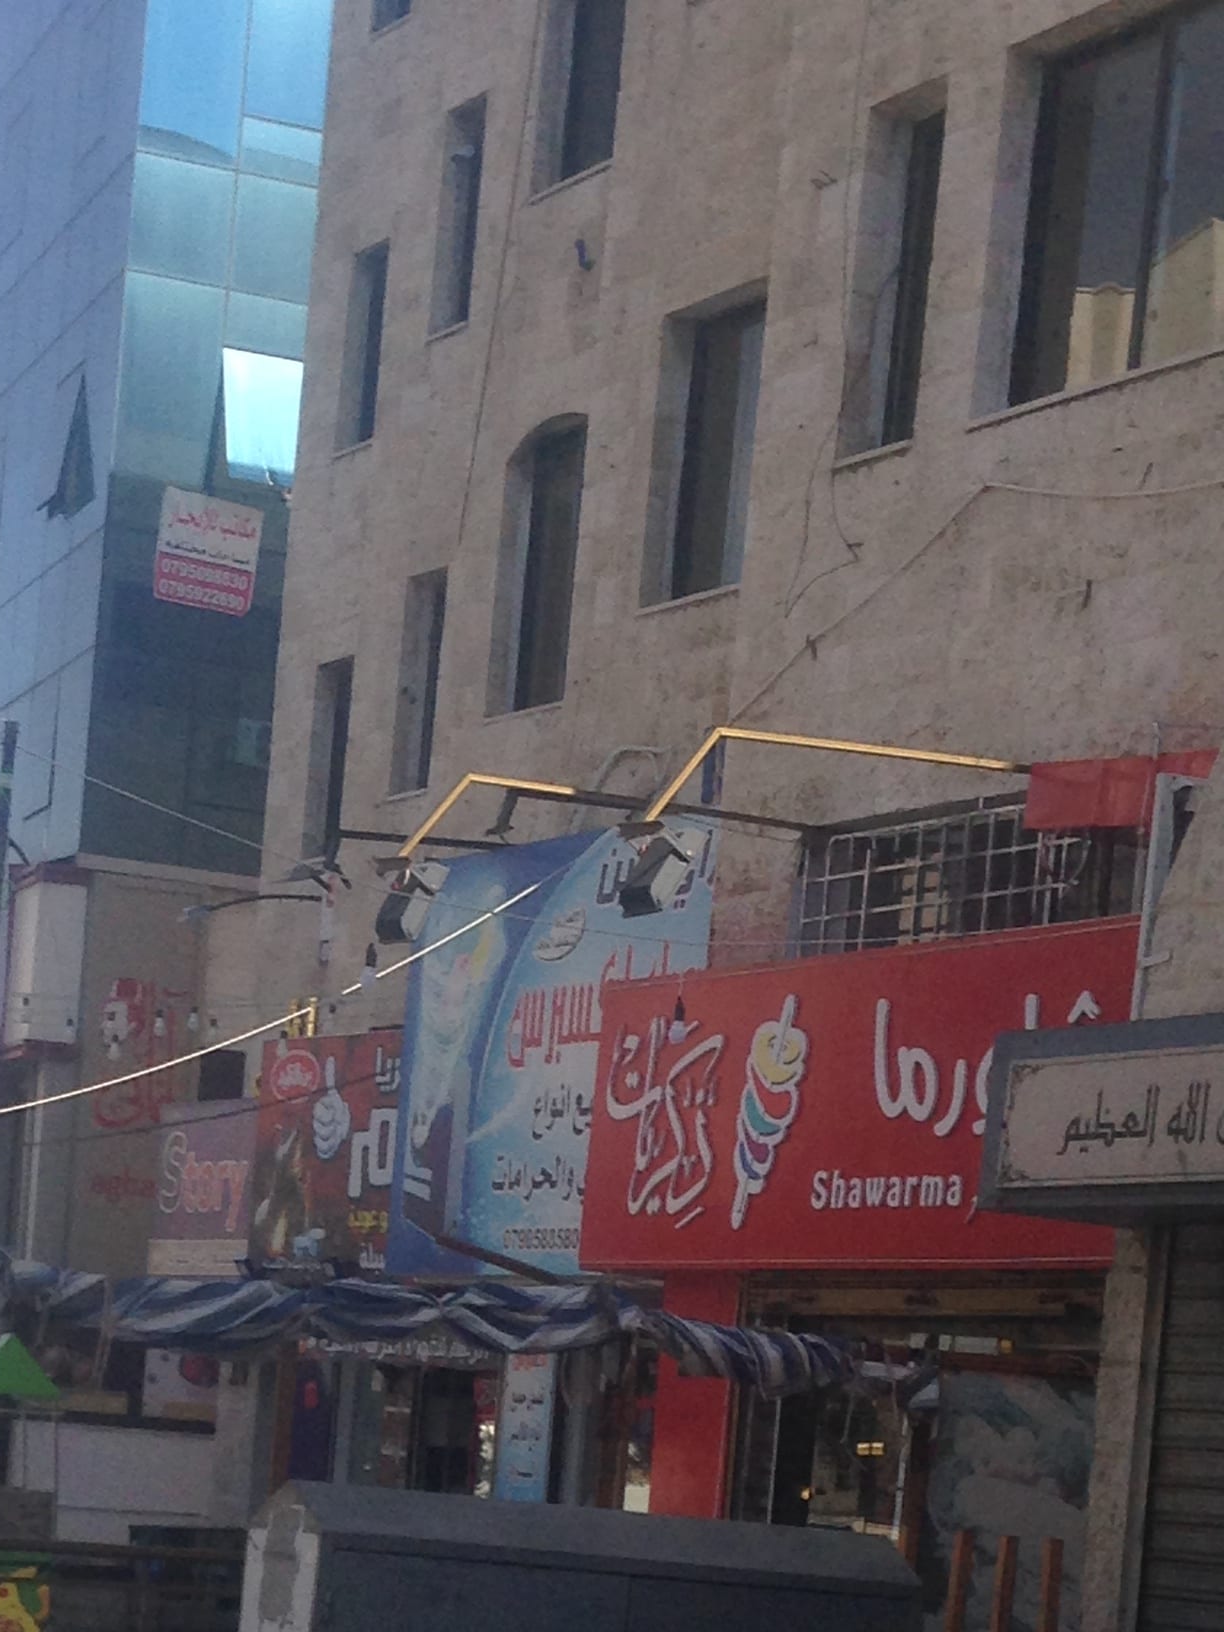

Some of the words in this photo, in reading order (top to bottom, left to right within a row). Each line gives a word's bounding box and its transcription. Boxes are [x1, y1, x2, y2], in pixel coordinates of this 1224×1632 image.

[1056, 1083, 1161, 1156] العظيم
[1167, 1079, 1212, 1144] الله
[158, 1131, 249, 1232] Story
[810, 1168, 963, 1209] Shawarma
